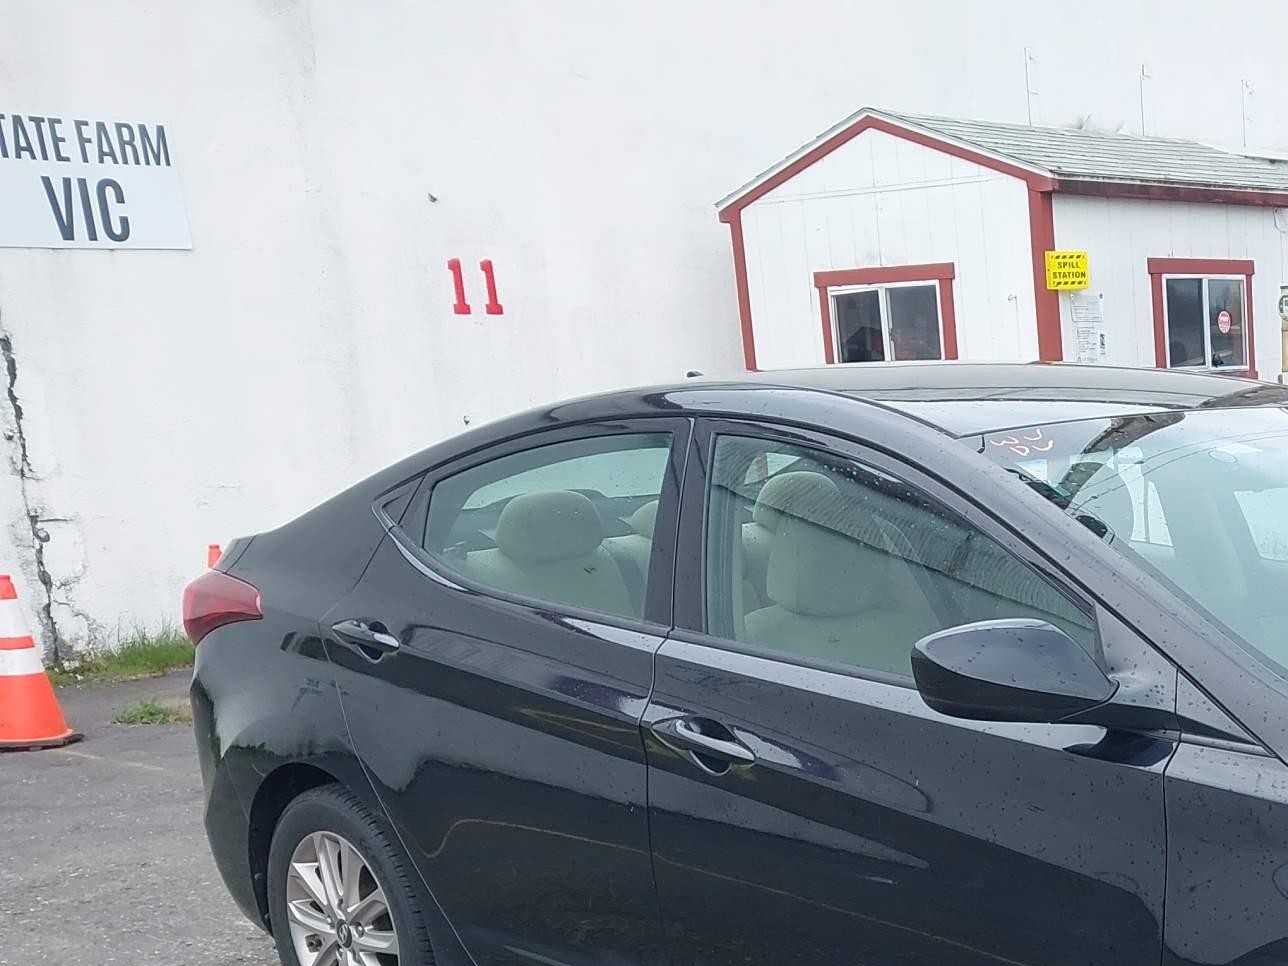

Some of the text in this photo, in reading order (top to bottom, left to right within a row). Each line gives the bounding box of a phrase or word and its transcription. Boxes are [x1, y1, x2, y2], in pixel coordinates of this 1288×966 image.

[74, 120, 171, 167] FARM
[40, 175, 131, 243] VIC
[447, 258, 504, 315] 11
[1052, 271, 1086, 279] STATION
[1057, 261, 1081, 269] SPILL
